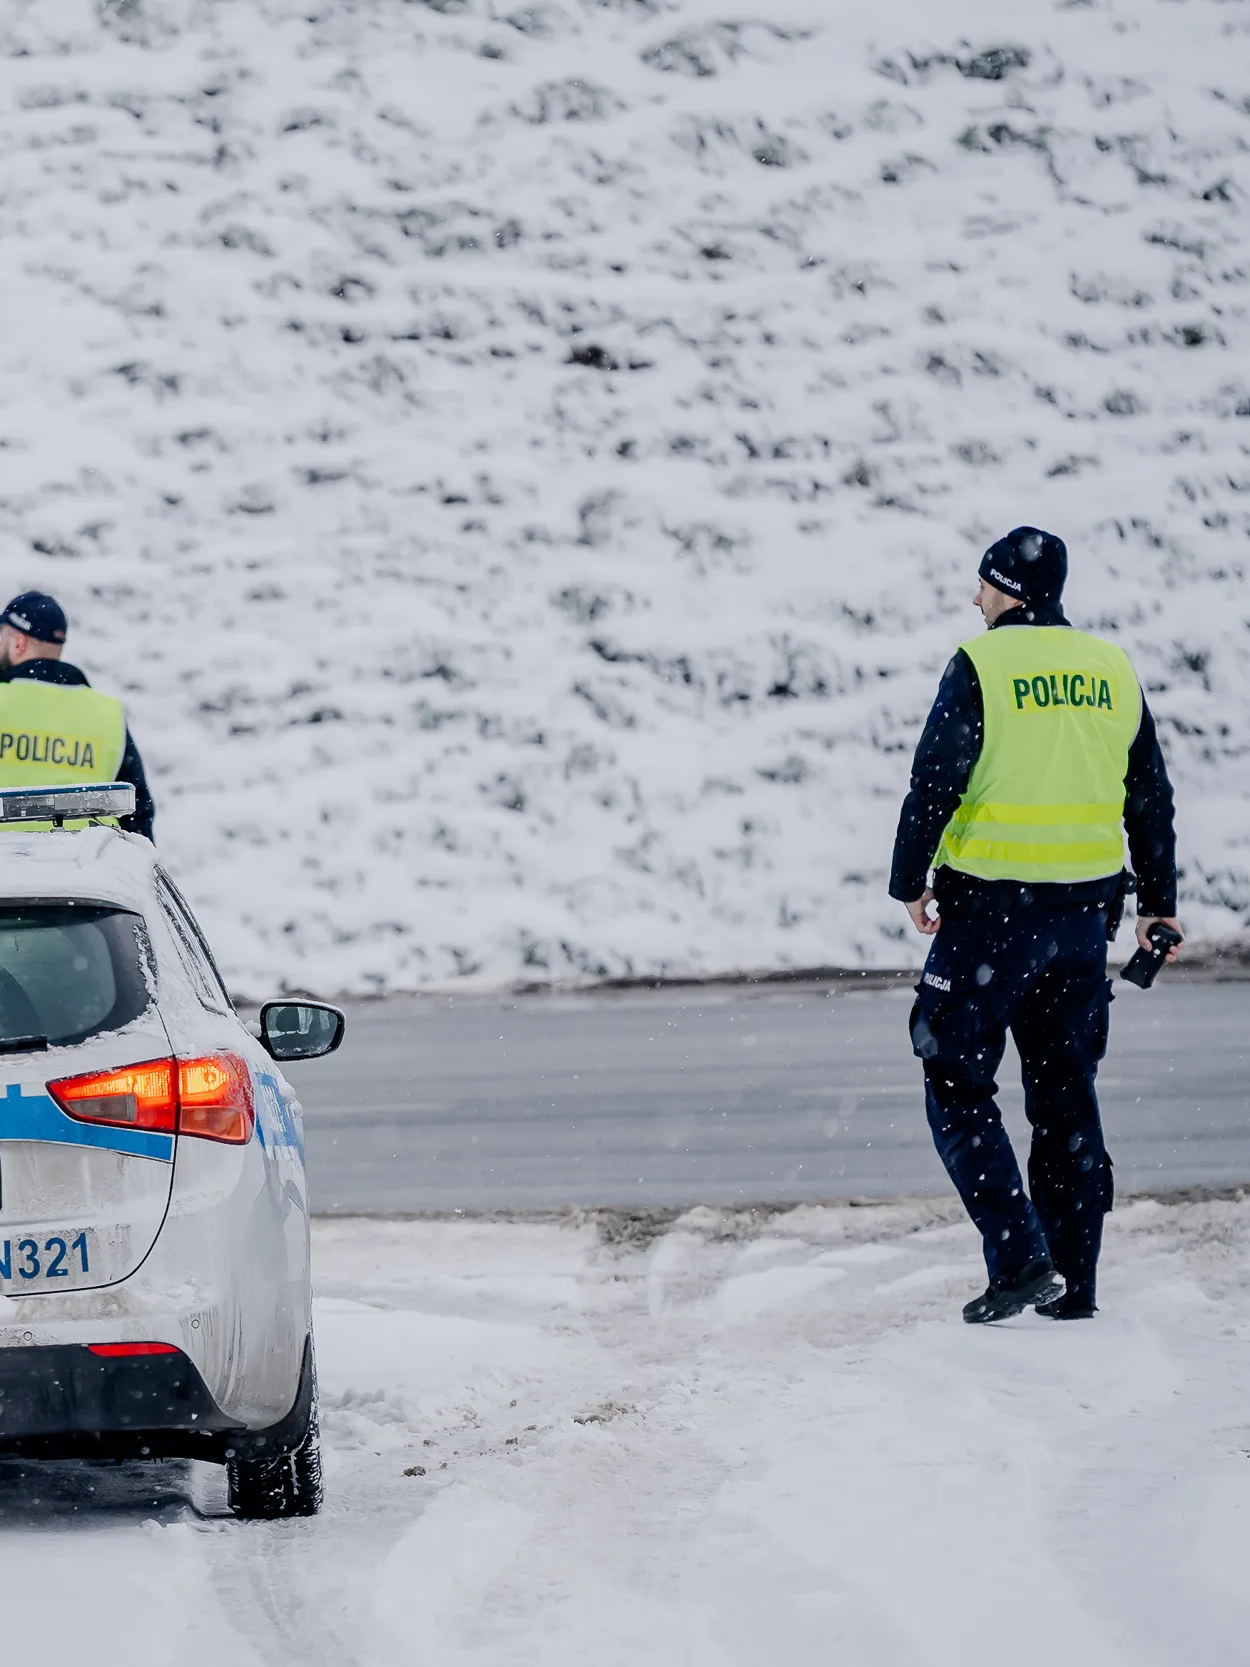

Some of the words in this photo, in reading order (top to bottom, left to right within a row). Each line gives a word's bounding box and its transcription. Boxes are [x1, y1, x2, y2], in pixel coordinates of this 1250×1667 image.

[990, 569, 1022, 592] POLICJA
[1013, 674, 1113, 710] POLICJA
[0, 733, 95, 769] POLICJA
